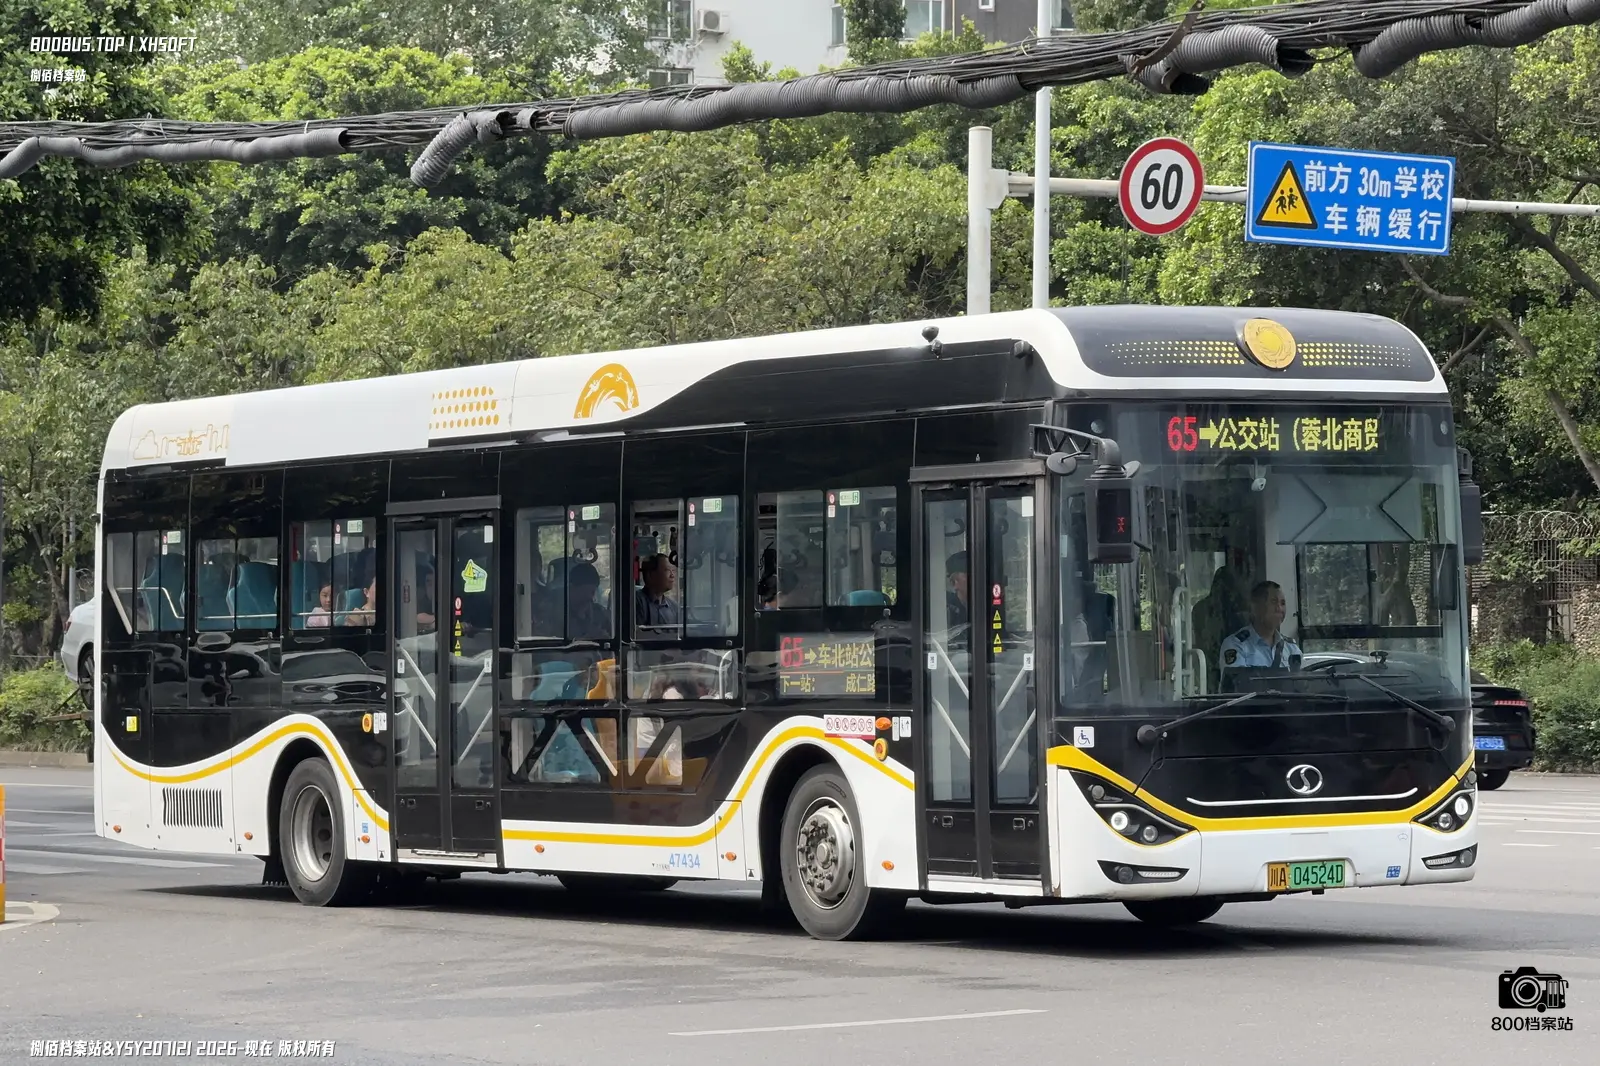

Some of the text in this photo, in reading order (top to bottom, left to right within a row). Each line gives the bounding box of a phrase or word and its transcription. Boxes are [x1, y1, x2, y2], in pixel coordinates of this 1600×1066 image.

[1141, 163, 1183, 210] 60
[1324, 203, 1442, 241] 车辆缓行
[1168, 416, 1198, 451] 65
[780, 637, 875, 668] 65 车北站公
[669, 853, 700, 868] 47434
